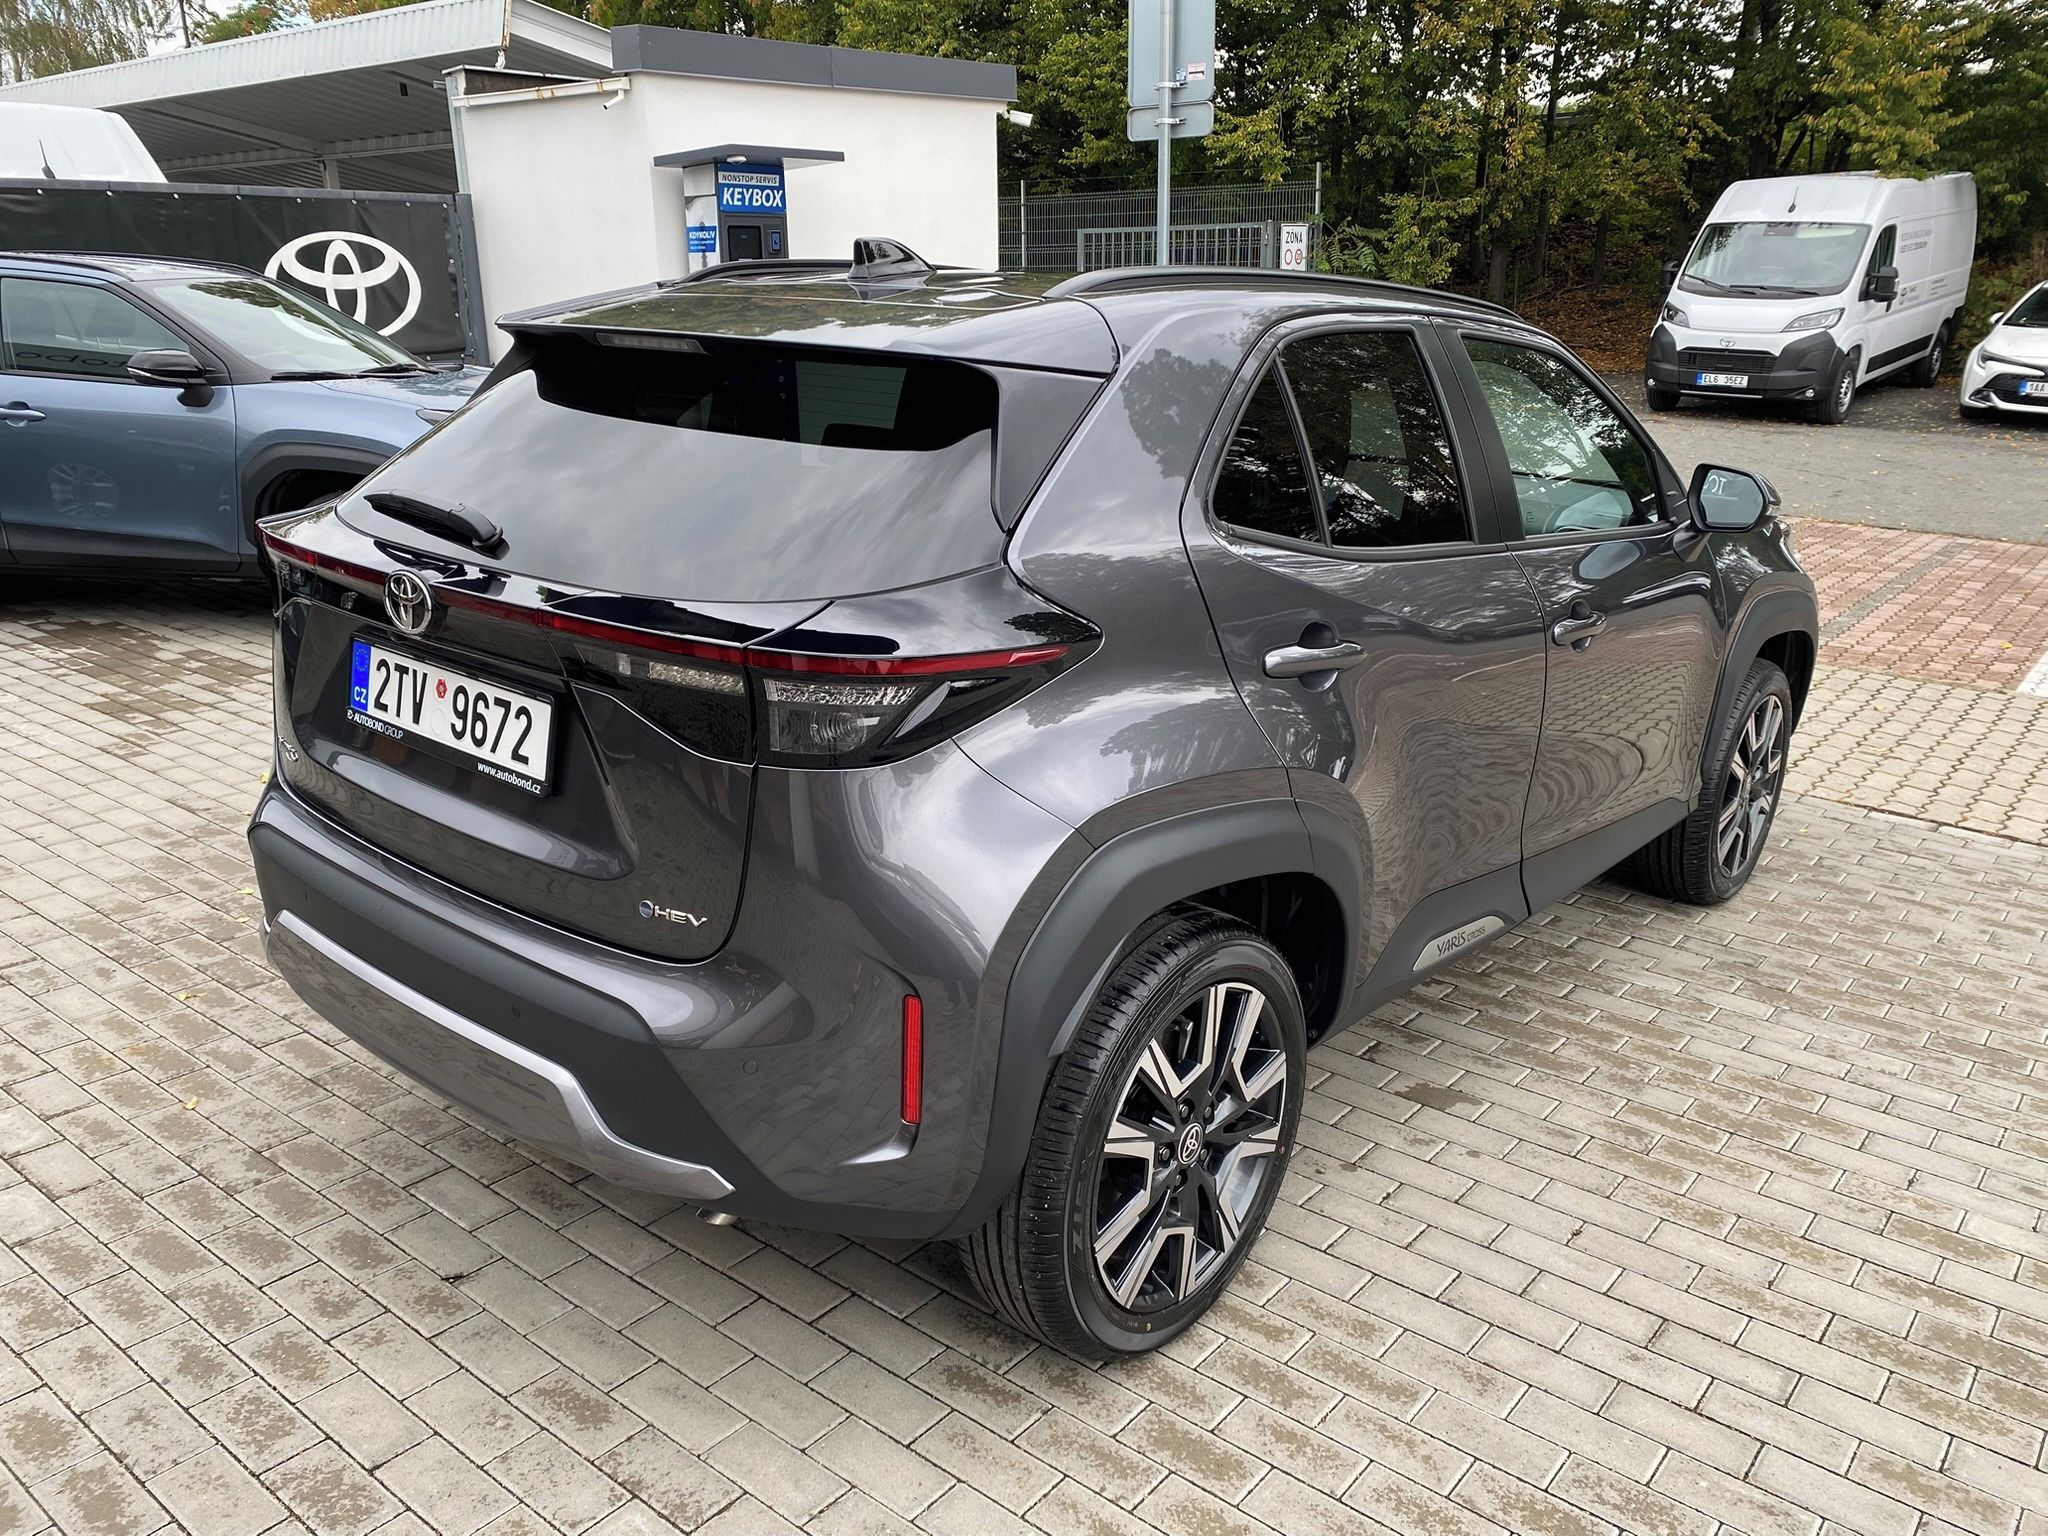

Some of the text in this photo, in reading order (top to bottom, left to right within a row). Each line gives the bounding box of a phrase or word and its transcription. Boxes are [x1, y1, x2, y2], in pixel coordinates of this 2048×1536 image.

[722, 174, 777, 184] NONSTOP SERVIS
[723, 187, 783, 207] KEYBOX
[1286, 229, 1302, 243] ZÓNA
[354, 686, 367, 704] CZ
[374, 658, 533, 766] 2TV 9672
[353, 712, 404, 740] AUTOBOND GROUP
[477, 762, 541, 794] www.autobond.cz
[655, 906, 707, 927] HEV
[1436, 931, 1466, 957] YARIS
